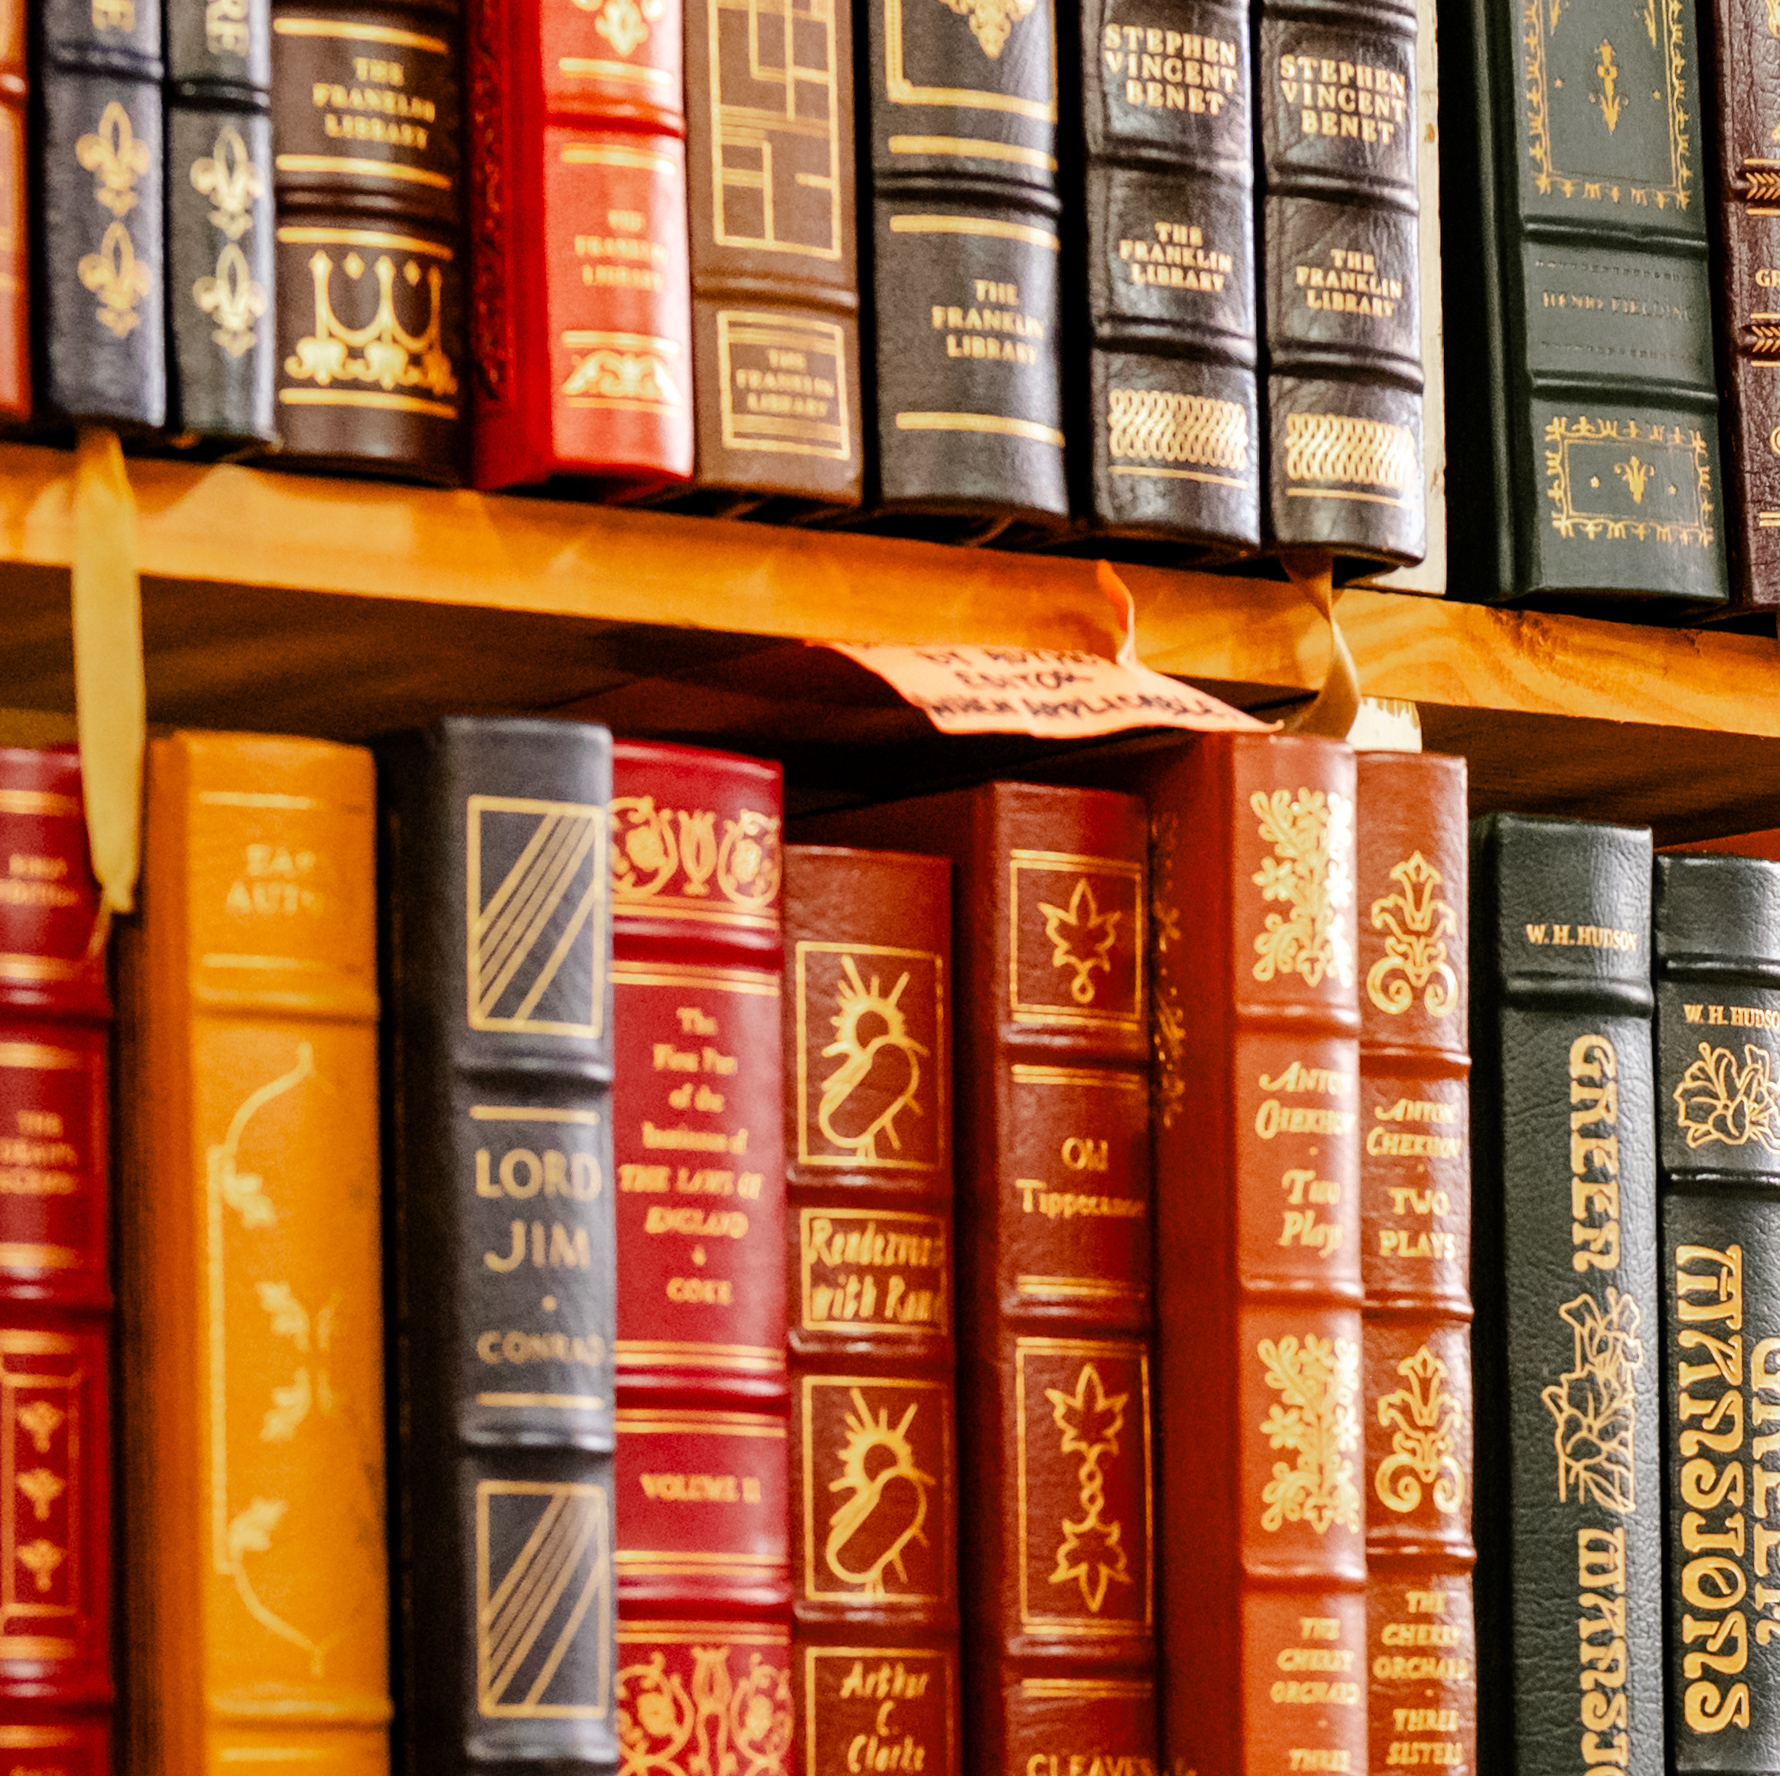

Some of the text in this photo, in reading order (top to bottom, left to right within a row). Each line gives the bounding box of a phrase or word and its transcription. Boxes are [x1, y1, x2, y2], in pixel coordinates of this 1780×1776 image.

[1103, 23, 1237, 69] STEPHEN
[1106, 51, 1240, 94] VINCENT
[1279, 54, 1406, 97] STEPHEN
[1125, 80, 1223, 116] BENET
[1281, 80, 1407, 121] VINCENT
[1300, 109, 1396, 146] BENET
[1155, 222, 1204, 249] THE
[1119, 239, 1232, 274] FRANKLIN
[1130, 261, 1226, 294] LIBRARY
[1526, 924, 1637, 952] W. H. HUDSON
[1375, 1099, 1458, 1124] ANTON
[1061, 1138, 1109, 1171] Old
[475, 1148, 602, 1199] LORD
[1390, 1188, 1450, 1216] TWO
[482, 1222, 591, 1272] JIM
[1379, 1231, 1455, 1259] PLAYS
[476, 1330, 605, 1366] CONRAD
[1406, 1591, 1446, 1616] THE
[1381, 1622, 1461, 1647] CHERRY
[840, 1661, 928, 1699] Arthur
[1372, 1653, 1468, 1681] ORCHARD
[1394, 1708, 1459, 1733] THREE
[846, 1736, 925, 1773] Clarke
[1386, 1739, 1462, 1766] SISTERS
